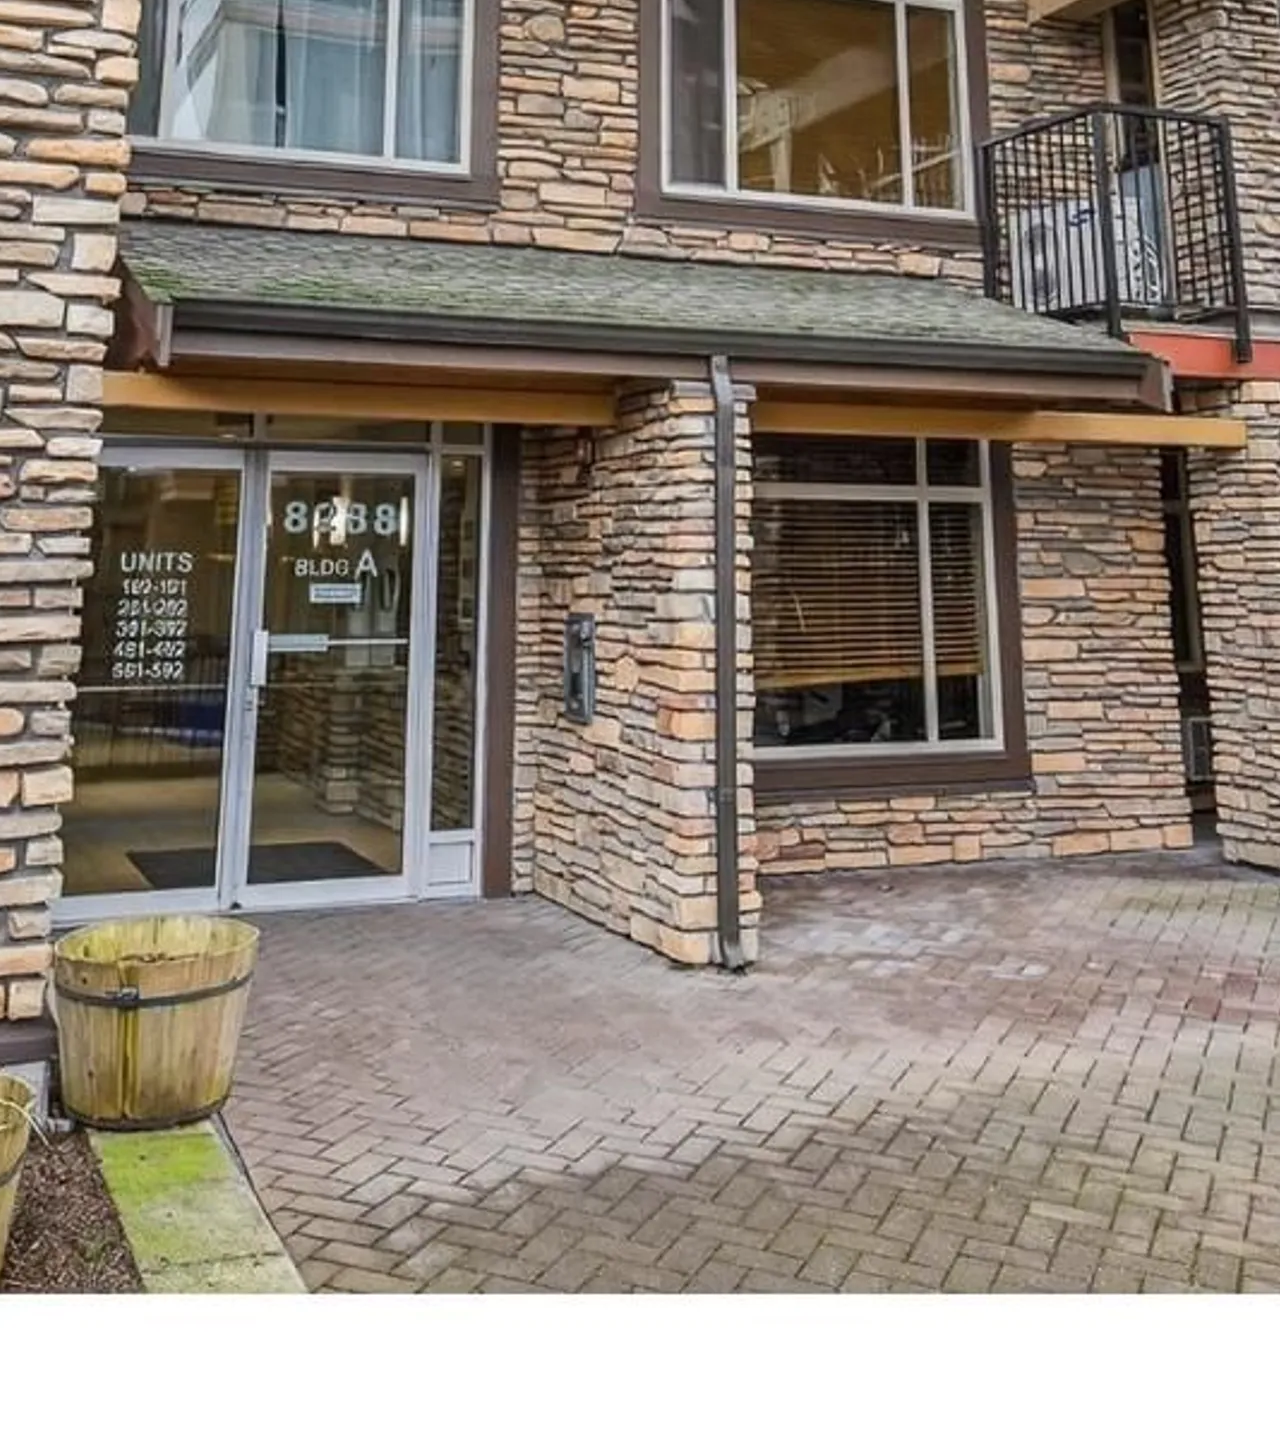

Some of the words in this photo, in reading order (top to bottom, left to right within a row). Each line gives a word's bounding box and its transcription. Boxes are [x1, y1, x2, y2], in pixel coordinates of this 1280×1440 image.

[120, 551, 193, 573] UNITS
[294, 559, 349, 577] BLDG
[354, 548, 378, 580] A
